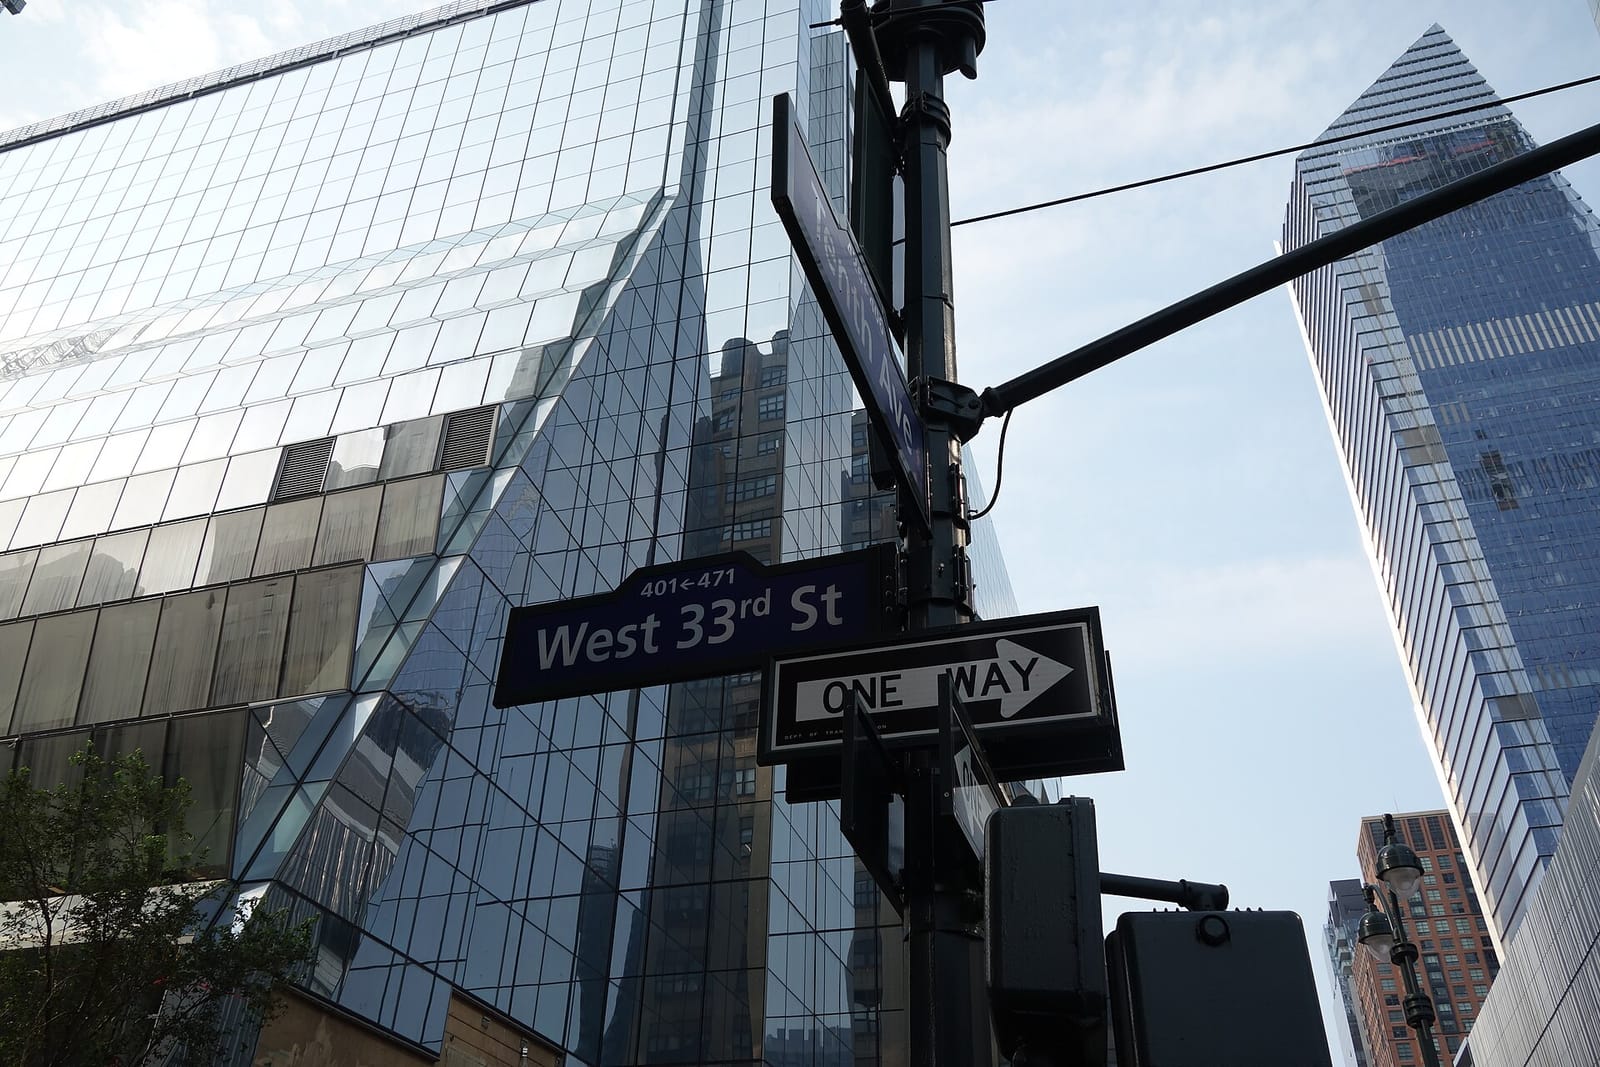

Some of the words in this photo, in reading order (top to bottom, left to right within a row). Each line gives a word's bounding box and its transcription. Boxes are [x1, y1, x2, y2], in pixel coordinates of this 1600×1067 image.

[811, 180, 873, 364] Tenth
[879, 352, 914, 453] Ave
[640, 579, 677, 597] 401
[698, 569, 735, 587] 471
[537, 613, 661, 670] West
[677, 587, 771, 648] 33rd
[790, 584, 843, 632] St
[822, 673, 904, 714] ONE
[946, 656, 1039, 698] WAY
